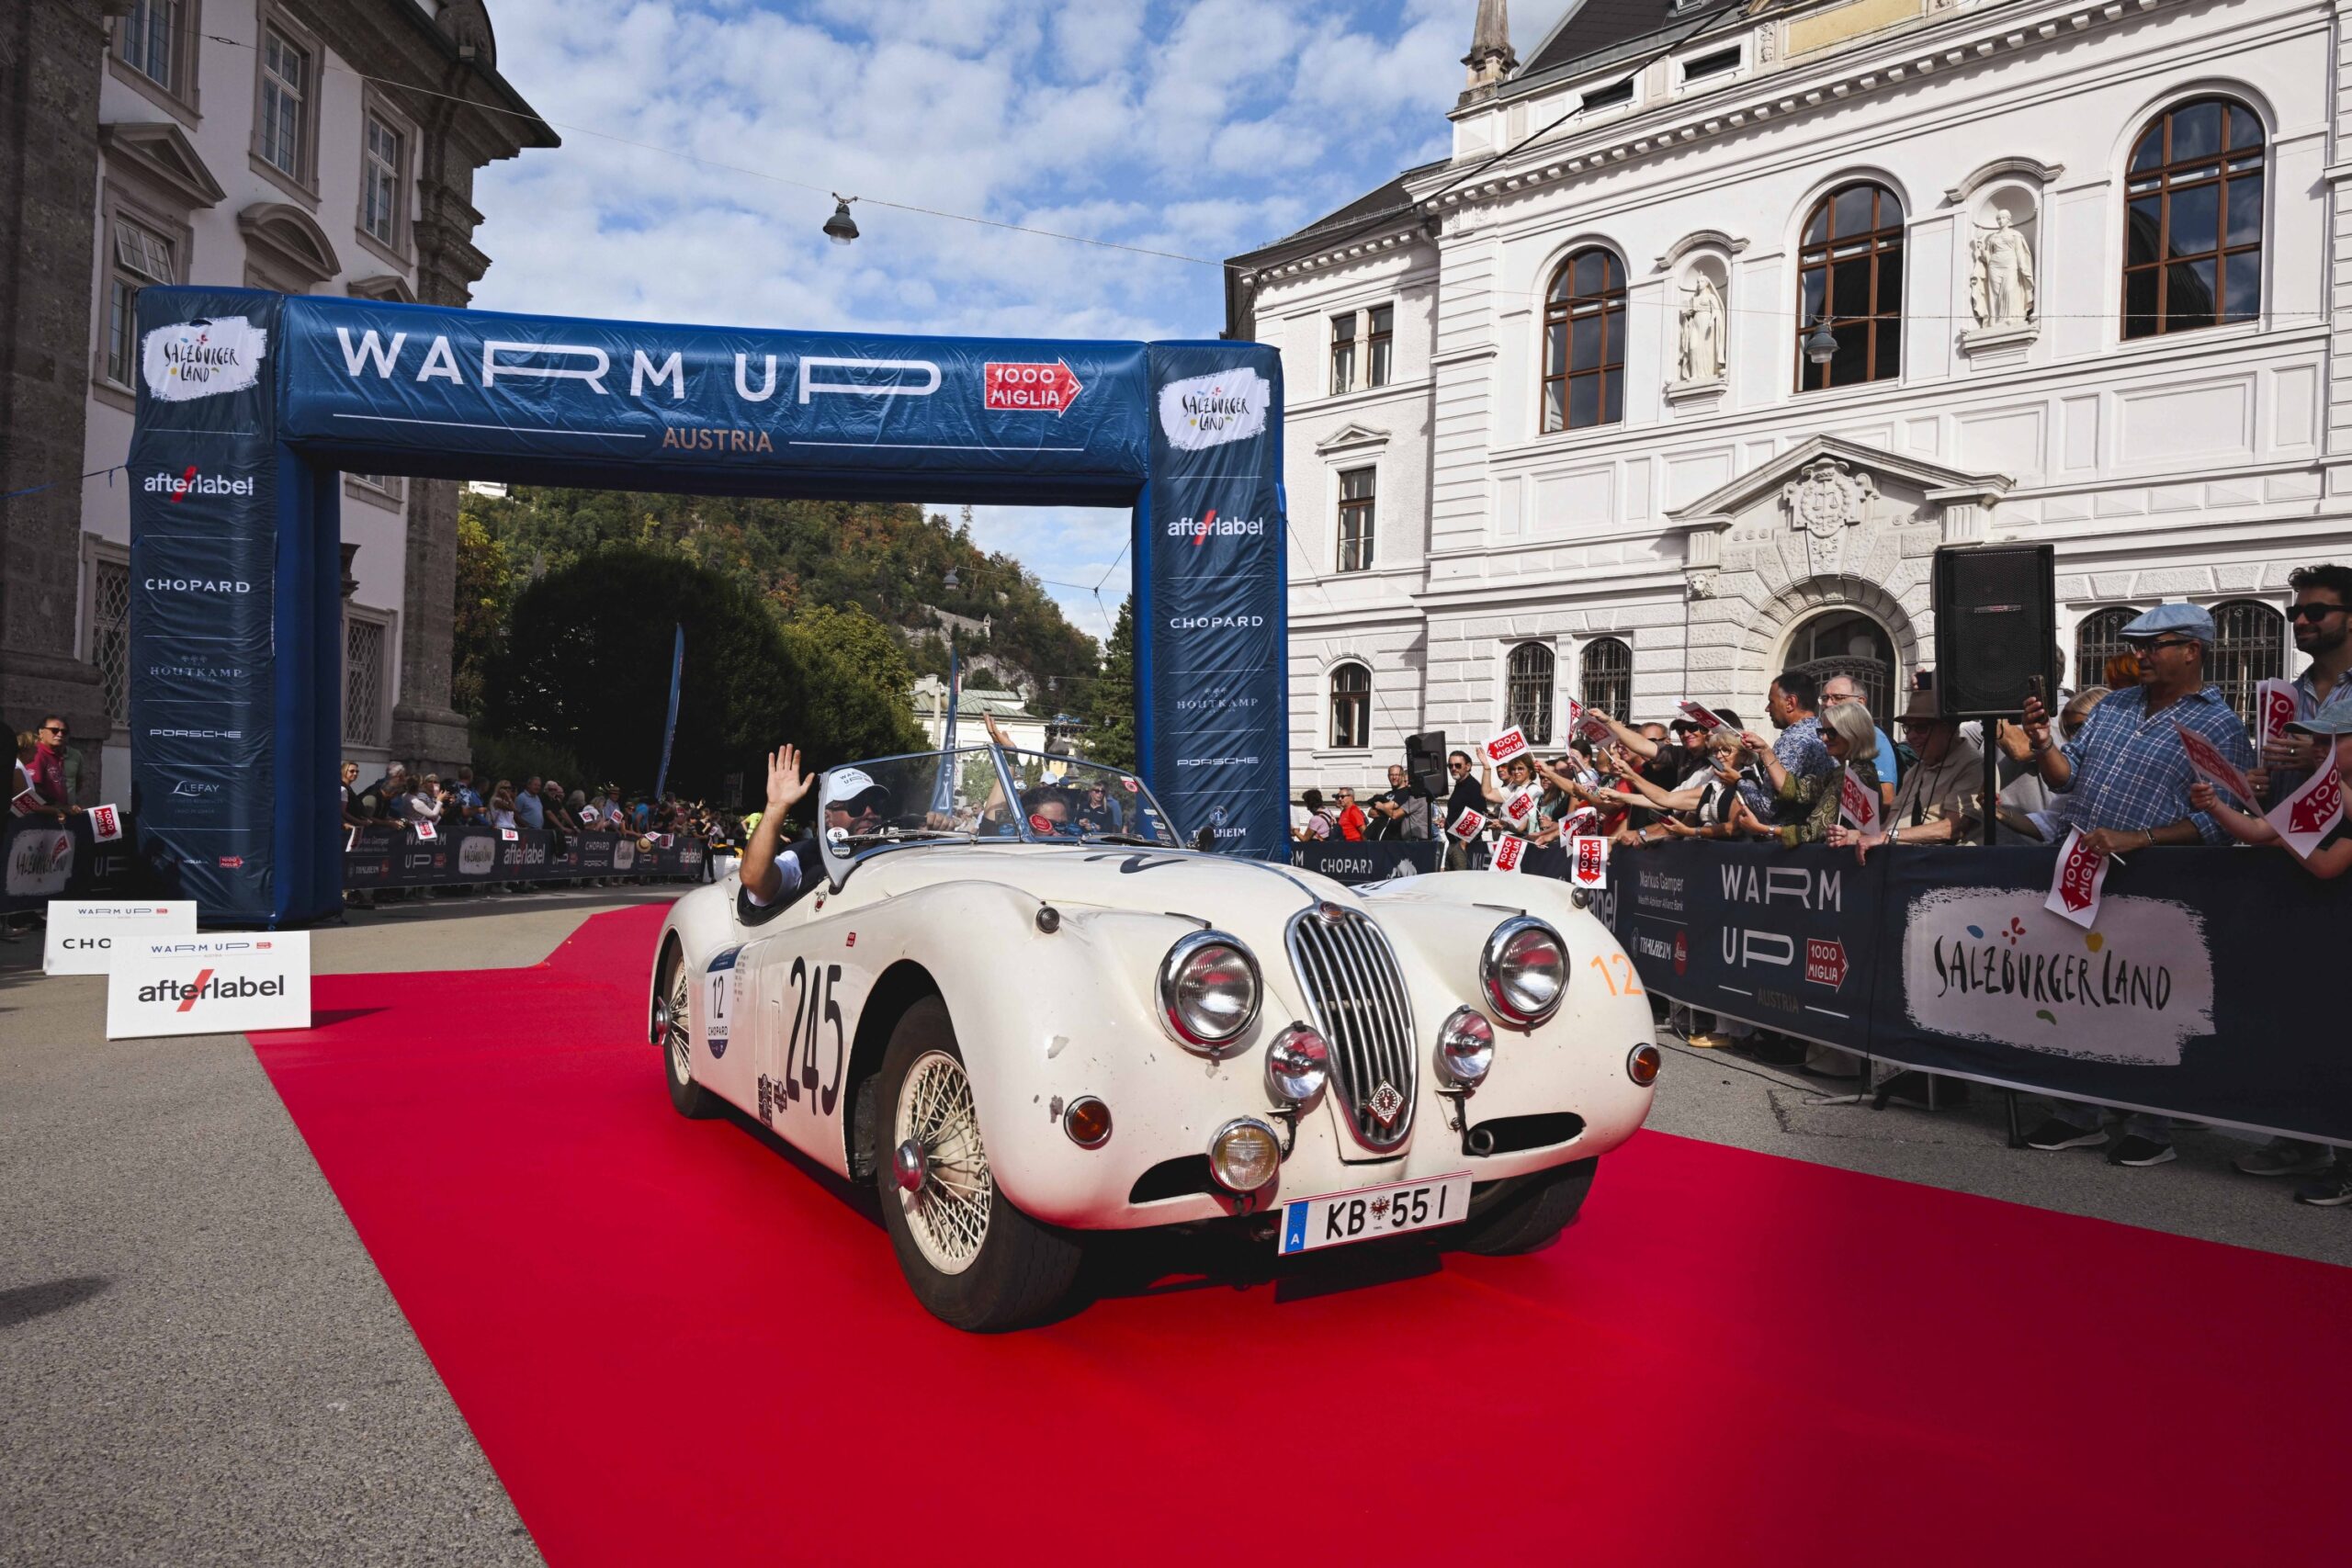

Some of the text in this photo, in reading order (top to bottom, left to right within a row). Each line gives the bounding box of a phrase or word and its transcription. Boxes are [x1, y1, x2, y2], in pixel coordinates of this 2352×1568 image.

[164, 342, 240, 367] SALZBURGER
[181, 363, 209, 382] LAND
[336, 326, 942, 404] WARM UP
[994, 368, 1055, 384] 1000
[990, 389, 1060, 407] MIGLIA
[1182, 394, 1250, 417] SALZBURGER
[1200, 414, 1224, 431] LAND
[662, 427, 773, 453] AUSTRIA
[144, 472, 254, 496] afterlabel
[1168, 517, 1262, 536] afterlabel
[145, 579, 251, 592] CHOPARD
[1170, 616, 1263, 628] CHOPARD
[150, 667, 243, 678] HOUTKAMP
[1177, 698, 1259, 709] HOUTKAMP
[150, 729, 242, 739] PORSCHE
[1494, 735, 1518, 749] 1000
[1497, 741, 1523, 759] MIGLIA
[1177, 757, 1260, 767] PORSCHE
[2306, 769, 2338, 807] 100
[1512, 796, 1527, 811] 1000
[2313, 790, 2341, 825] MIG
[104, 810, 114, 830] 1000
[1459, 814, 1474, 830] 1000
[1192, 828, 1247, 838] TLHEIM
[503, 843, 546, 864] afterlabel
[585, 841, 610, 851] CHOPARD
[1499, 840, 1512, 863] 1000
[1508, 840, 1521, 867] MIGLIA
[405, 854, 432, 869] UP
[1580, 844, 1590, 873] 1000
[1590, 841, 1600, 875] MIGLIA
[2065, 842, 2088, 888] 100
[1639, 870, 1684, 896] Markus Gamper
[2078, 852, 2100, 900] MIGLI
[1721, 863, 1841, 912] WARM
[152, 944, 208, 953] WARM
[215, 942, 250, 951] UP
[1639, 936, 1671, 961] THALHEIM
[1723, 926, 1794, 967] UP
[1811, 944, 1838, 961] 1000
[1590, 953, 1643, 997] 12
[1808, 963, 1838, 982] MIGLIA
[139, 975, 285, 1002] afterlabel
[712, 975, 724, 1019] 12
[1757, 987, 1799, 1014] AUSTRIA
[707, 1025, 729, 1036] CHOPARD
[786, 955, 843, 1116] 245
[1326, 1199, 1366, 1240] KB
[1290, 1233, 1300, 1245] A
